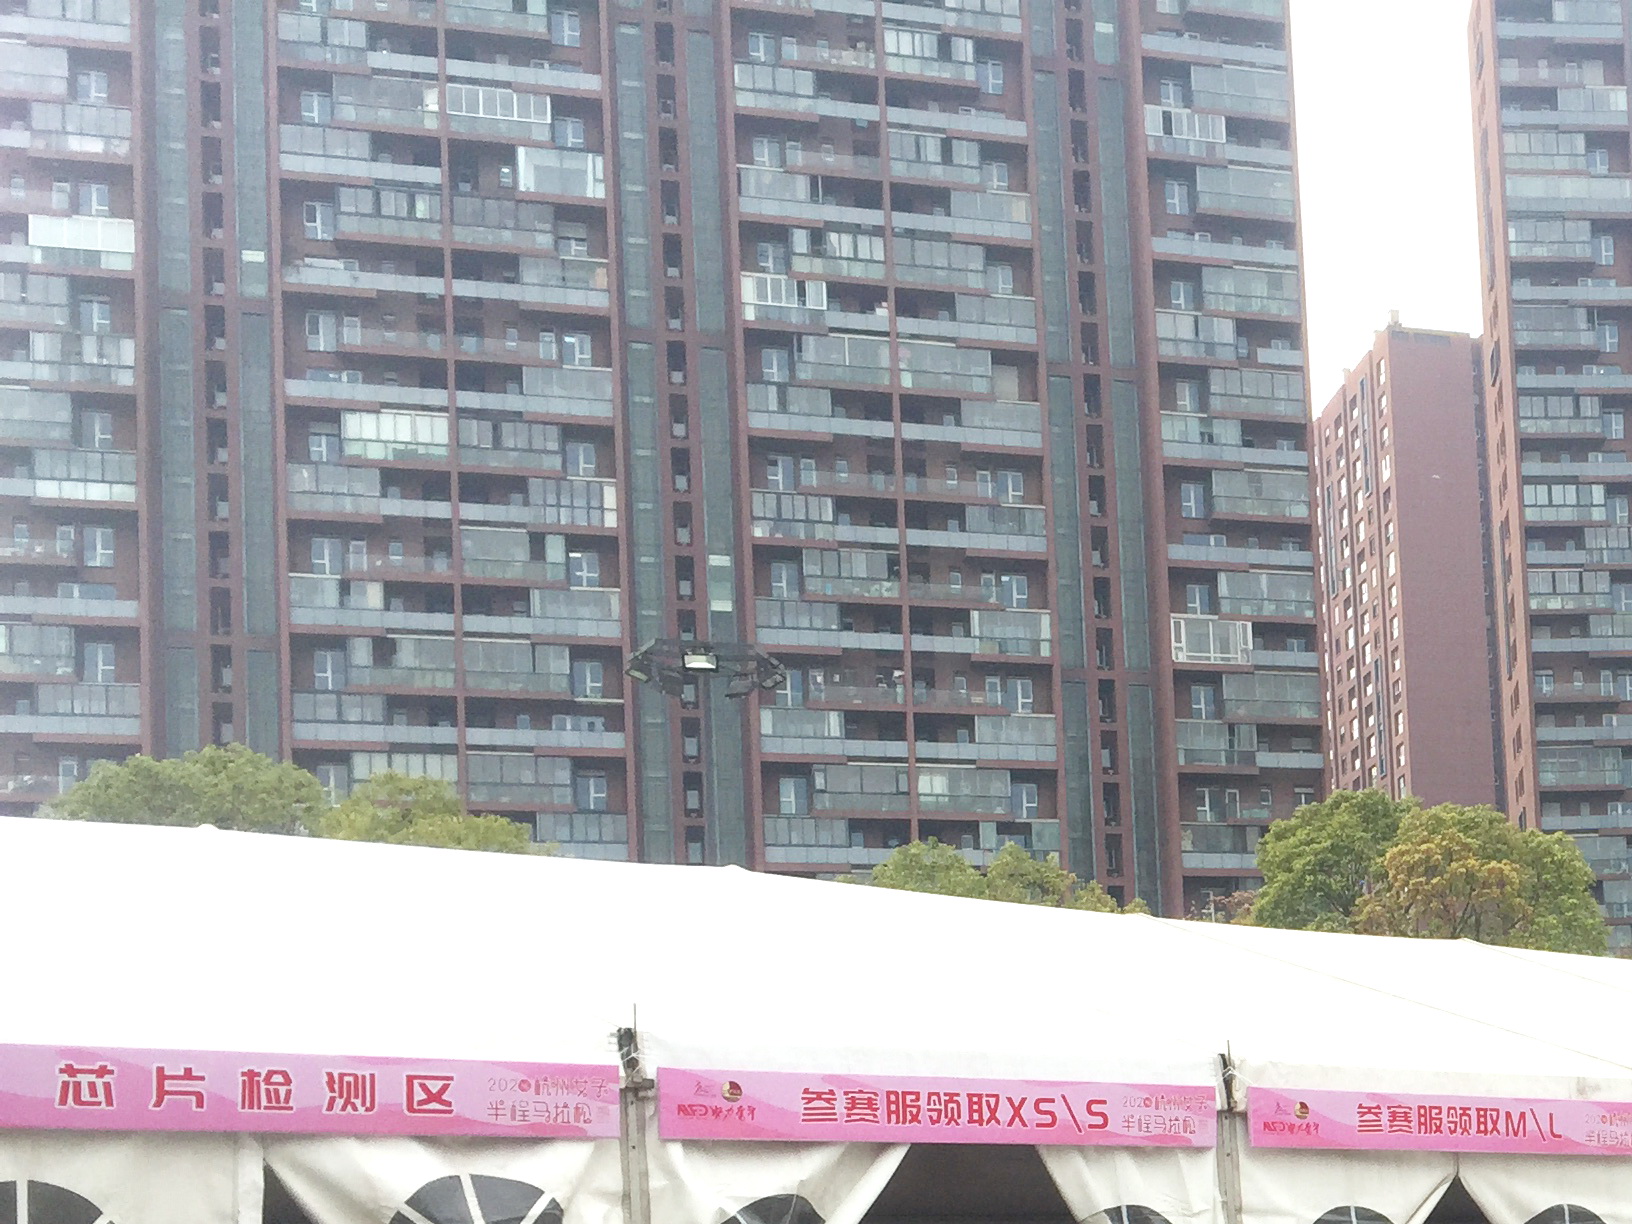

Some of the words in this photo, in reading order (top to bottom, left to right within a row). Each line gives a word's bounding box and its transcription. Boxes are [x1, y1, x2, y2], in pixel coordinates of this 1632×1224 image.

[58, 1063, 454, 1114] 芯片检测区
